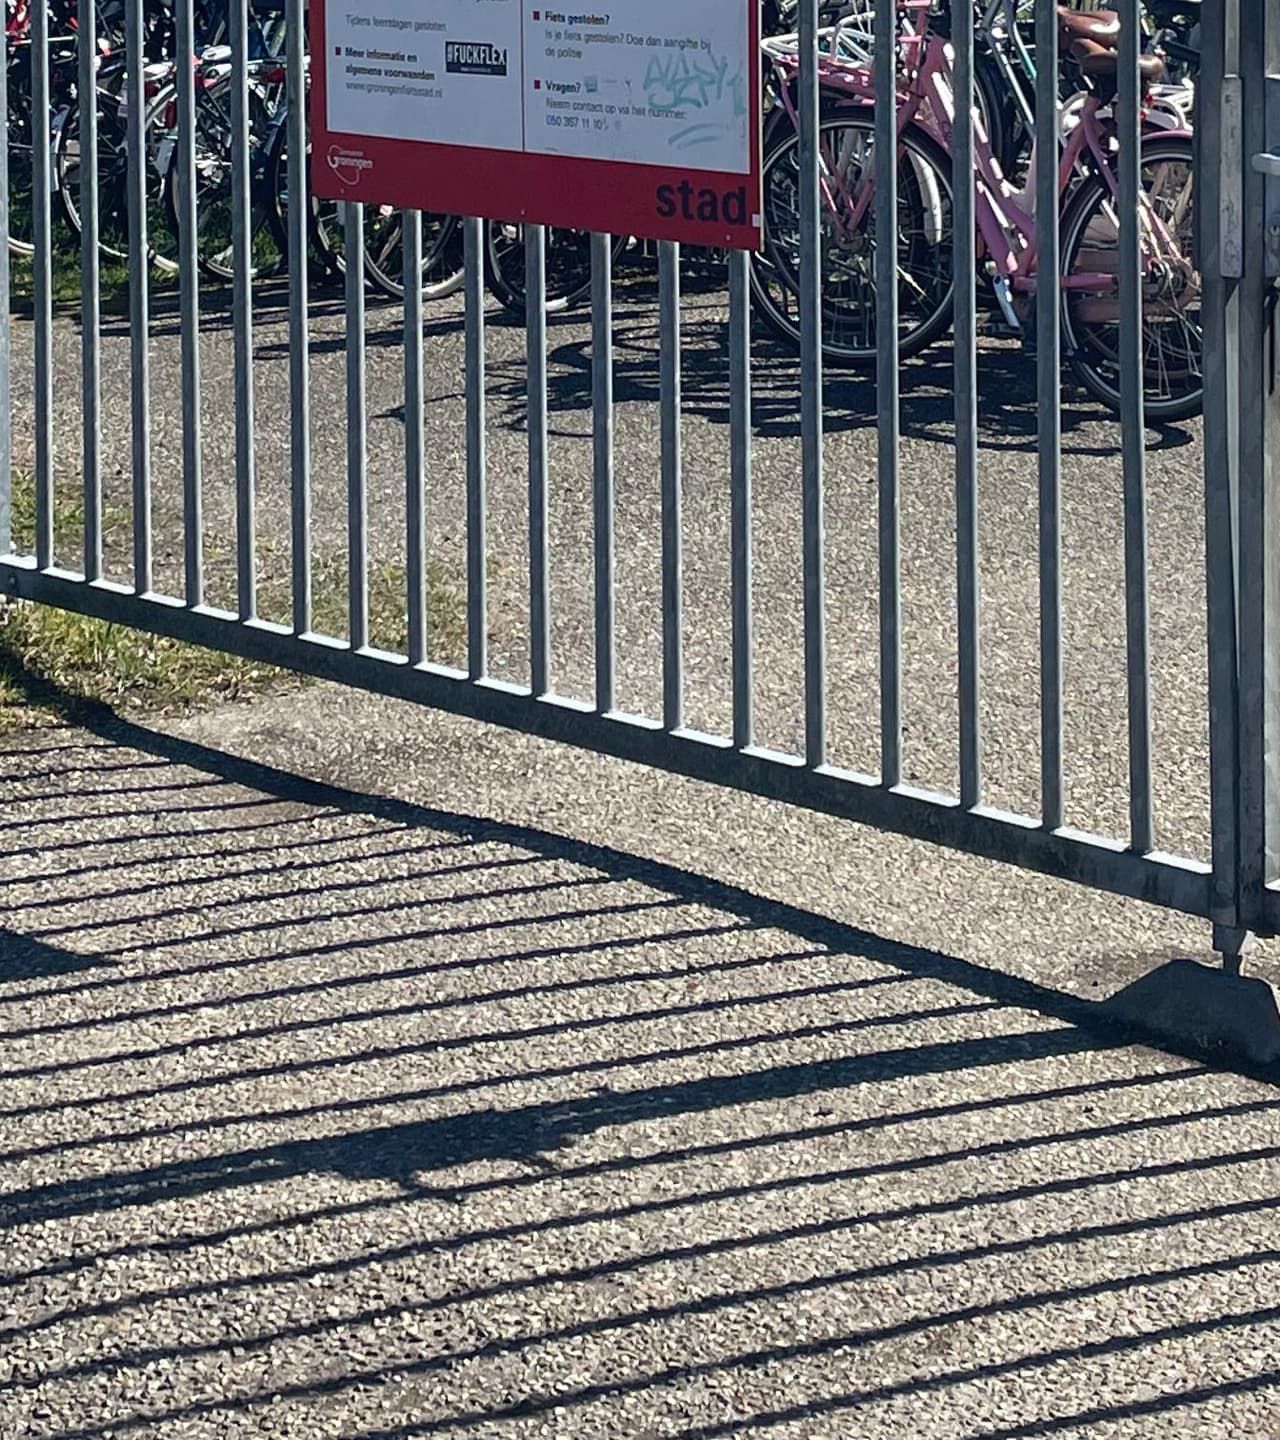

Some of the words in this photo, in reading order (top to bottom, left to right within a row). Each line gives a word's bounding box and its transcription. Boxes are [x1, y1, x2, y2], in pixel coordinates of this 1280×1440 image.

[345, 14, 370, 28] Tijdens
[414, 21, 446, 32] gesloten
[545, 11, 566, 23] Fiets
[568, 13, 610, 25] gestolen?
[545, 30, 553, 40] Is
[555, 30, 562, 41] je
[564, 30, 582, 41] fiets
[584, 32, 624, 44] gestolen?
[626, 35, 644, 46] Doe
[646, 36, 662, 47] dan
[664, 38, 698, 51] aangifte
[700, 39, 711, 53] bij
[345, 47, 364, 58] Meer
[366, 49, 405, 62] informatie
[545, 47, 555, 57] de
[384, 69, 435, 80] voorwaarden
[545, 80, 582, 94] Vragen?
[546, 97, 571, 109] Neem
[573, 100, 603, 112] contact
[605, 104, 617, 115] op
[619, 105, 630, 115] via
[632, 105, 646, 116] het
[546, 114, 561, 126] 050
[655, 180, 747, 225] stad
